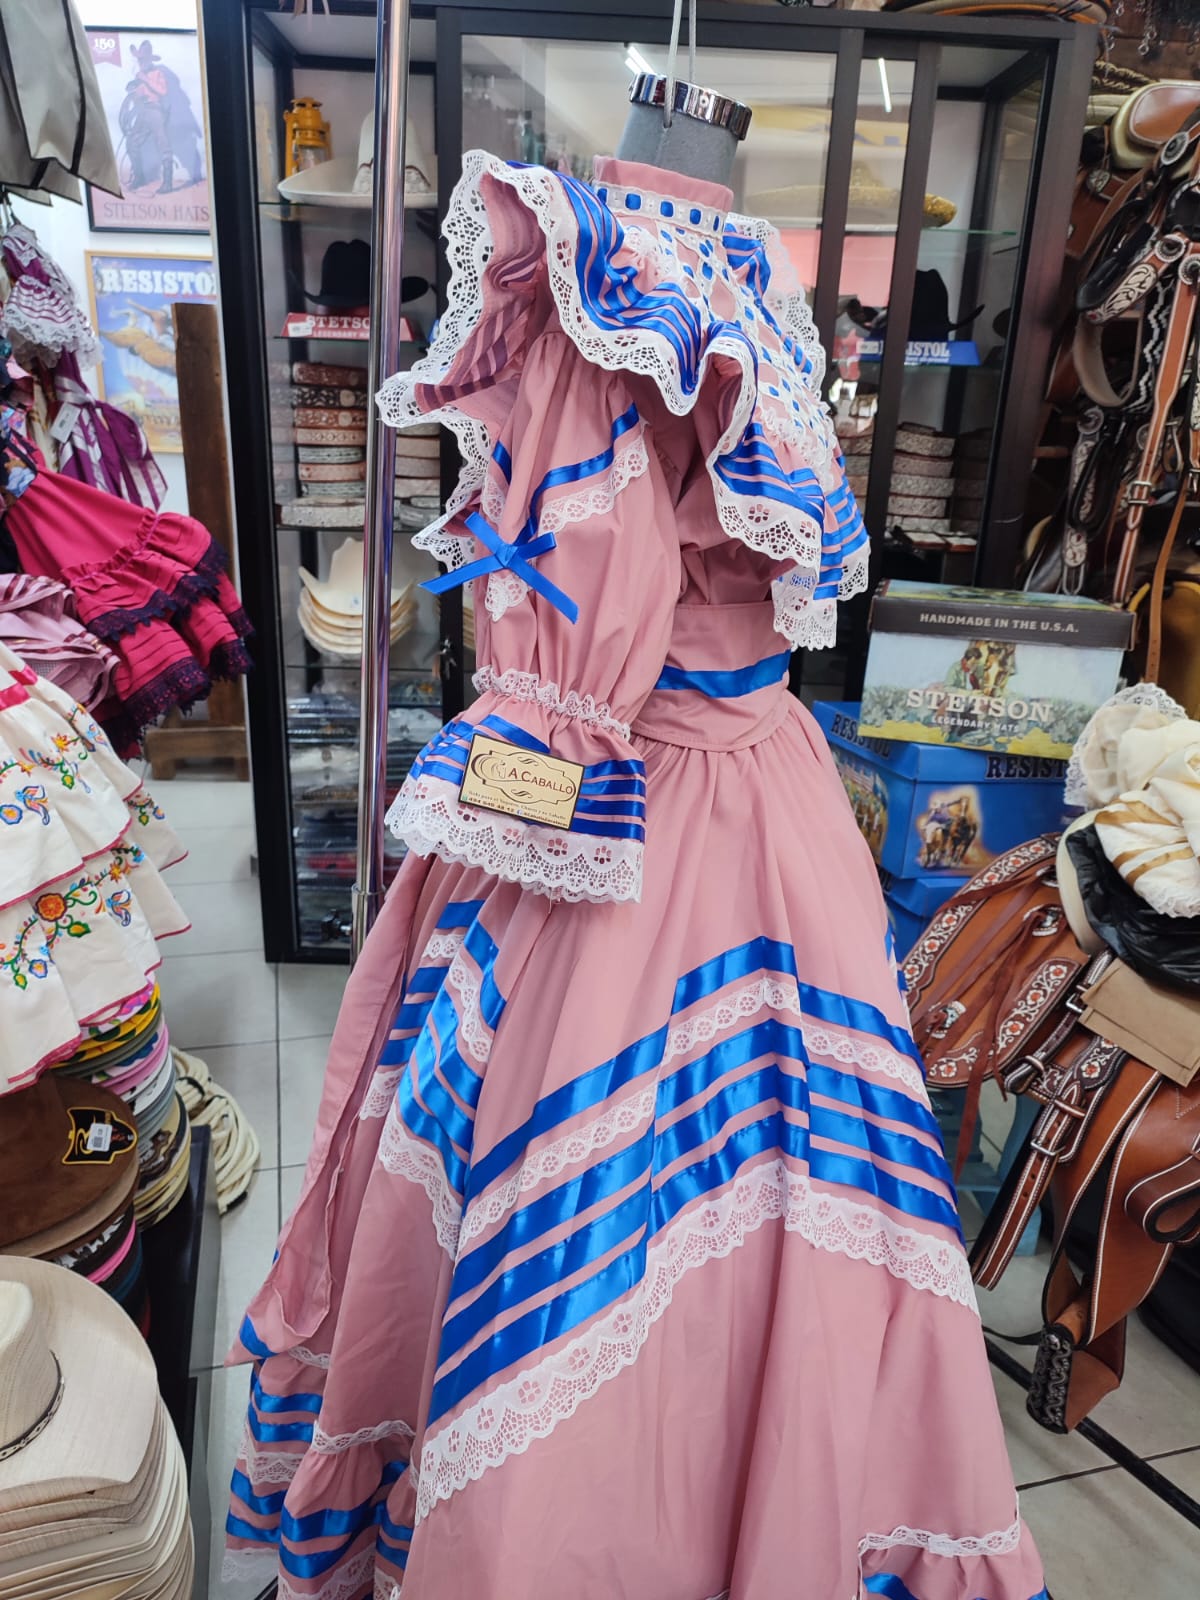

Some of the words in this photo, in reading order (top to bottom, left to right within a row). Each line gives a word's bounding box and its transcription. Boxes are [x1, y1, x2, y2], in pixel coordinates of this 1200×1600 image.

[95, 38, 116, 50] 150
[103, 202, 167, 220] STETSON
[173, 205, 210, 223] HATS
[306, 315, 370, 329] STETSO
[919, 612, 992, 628] HANDMADE
[994, 618, 1009, 629] IN
[1011, 619, 1037, 631] THE
[1039, 621, 1079, 634] U.S.A.
[905, 688, 1053, 723] STETSON
[931, 714, 991, 730] LEGENDARY
[508, 767, 518, 780] A
[985, 754, 1069, 780] RESIST
